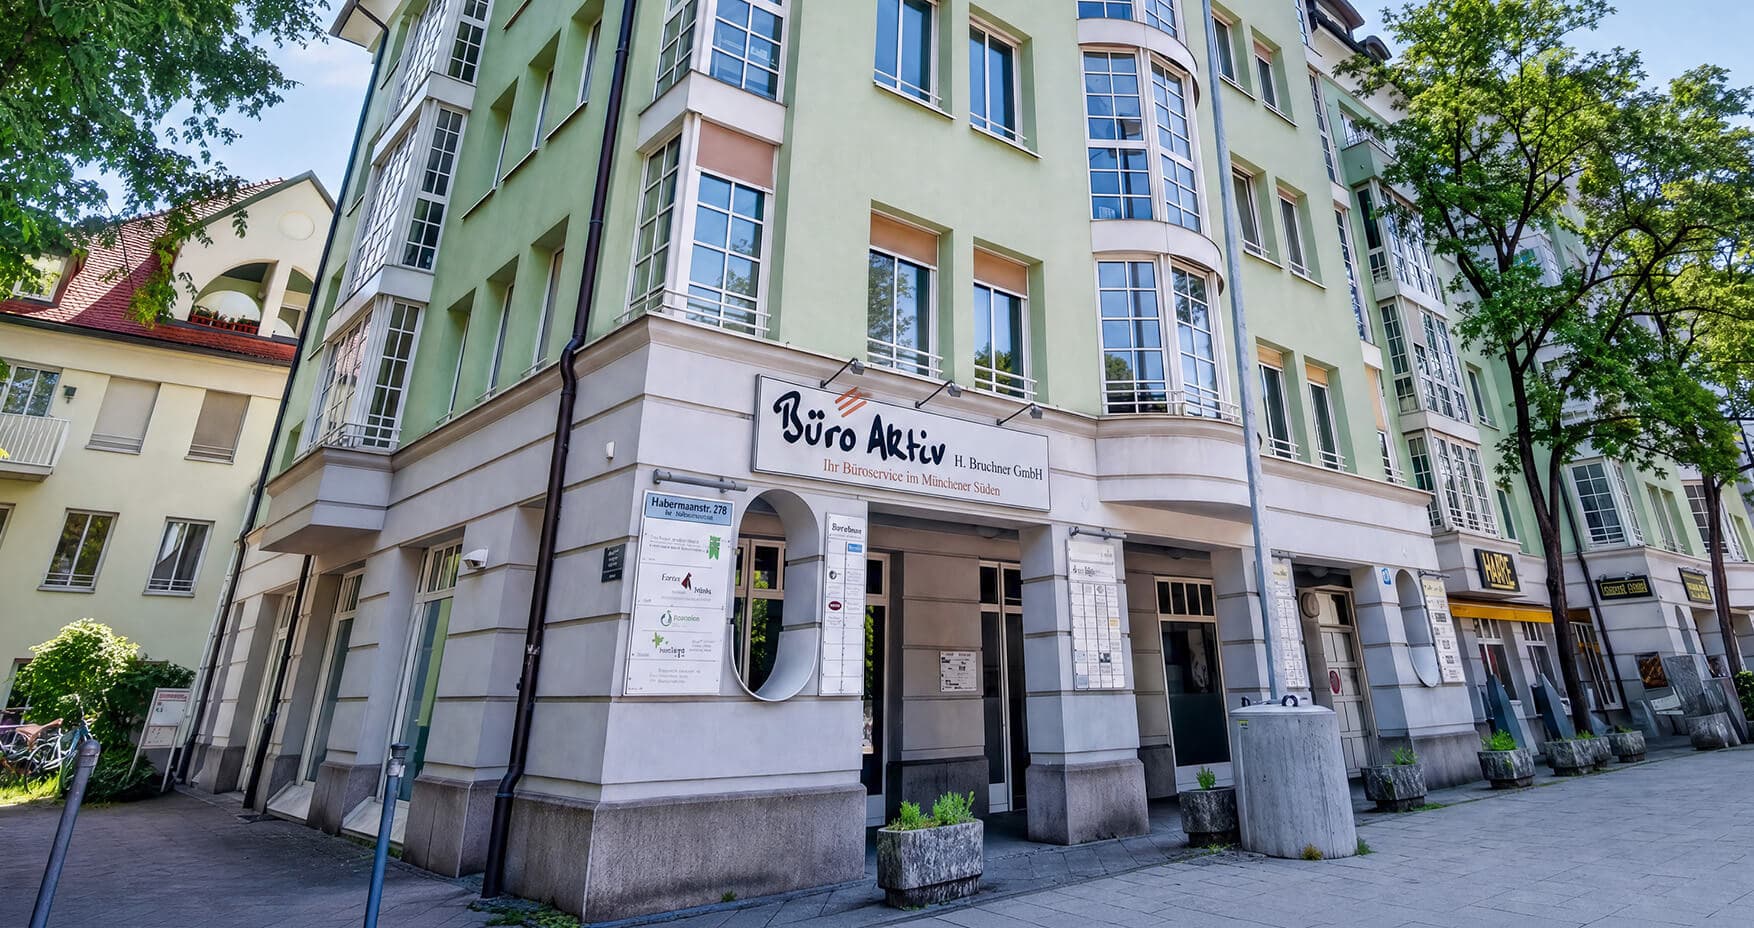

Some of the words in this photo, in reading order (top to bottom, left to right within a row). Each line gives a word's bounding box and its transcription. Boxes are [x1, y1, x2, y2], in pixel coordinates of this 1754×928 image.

[773, 391, 857, 452] Büro
[823, 458, 840, 473] Ihr
[842, 459, 904, 482] Büroservice
[906, 470, 919, 484] im
[922, 473, 972, 493] Münchener
[973, 481, 1001, 497] Süden
[954, 454, 967, 469] H.
[969, 456, 1012, 476] Bruchner
[1013, 464, 1043, 481] GmbH
[713, 504, 728, 516] 278
